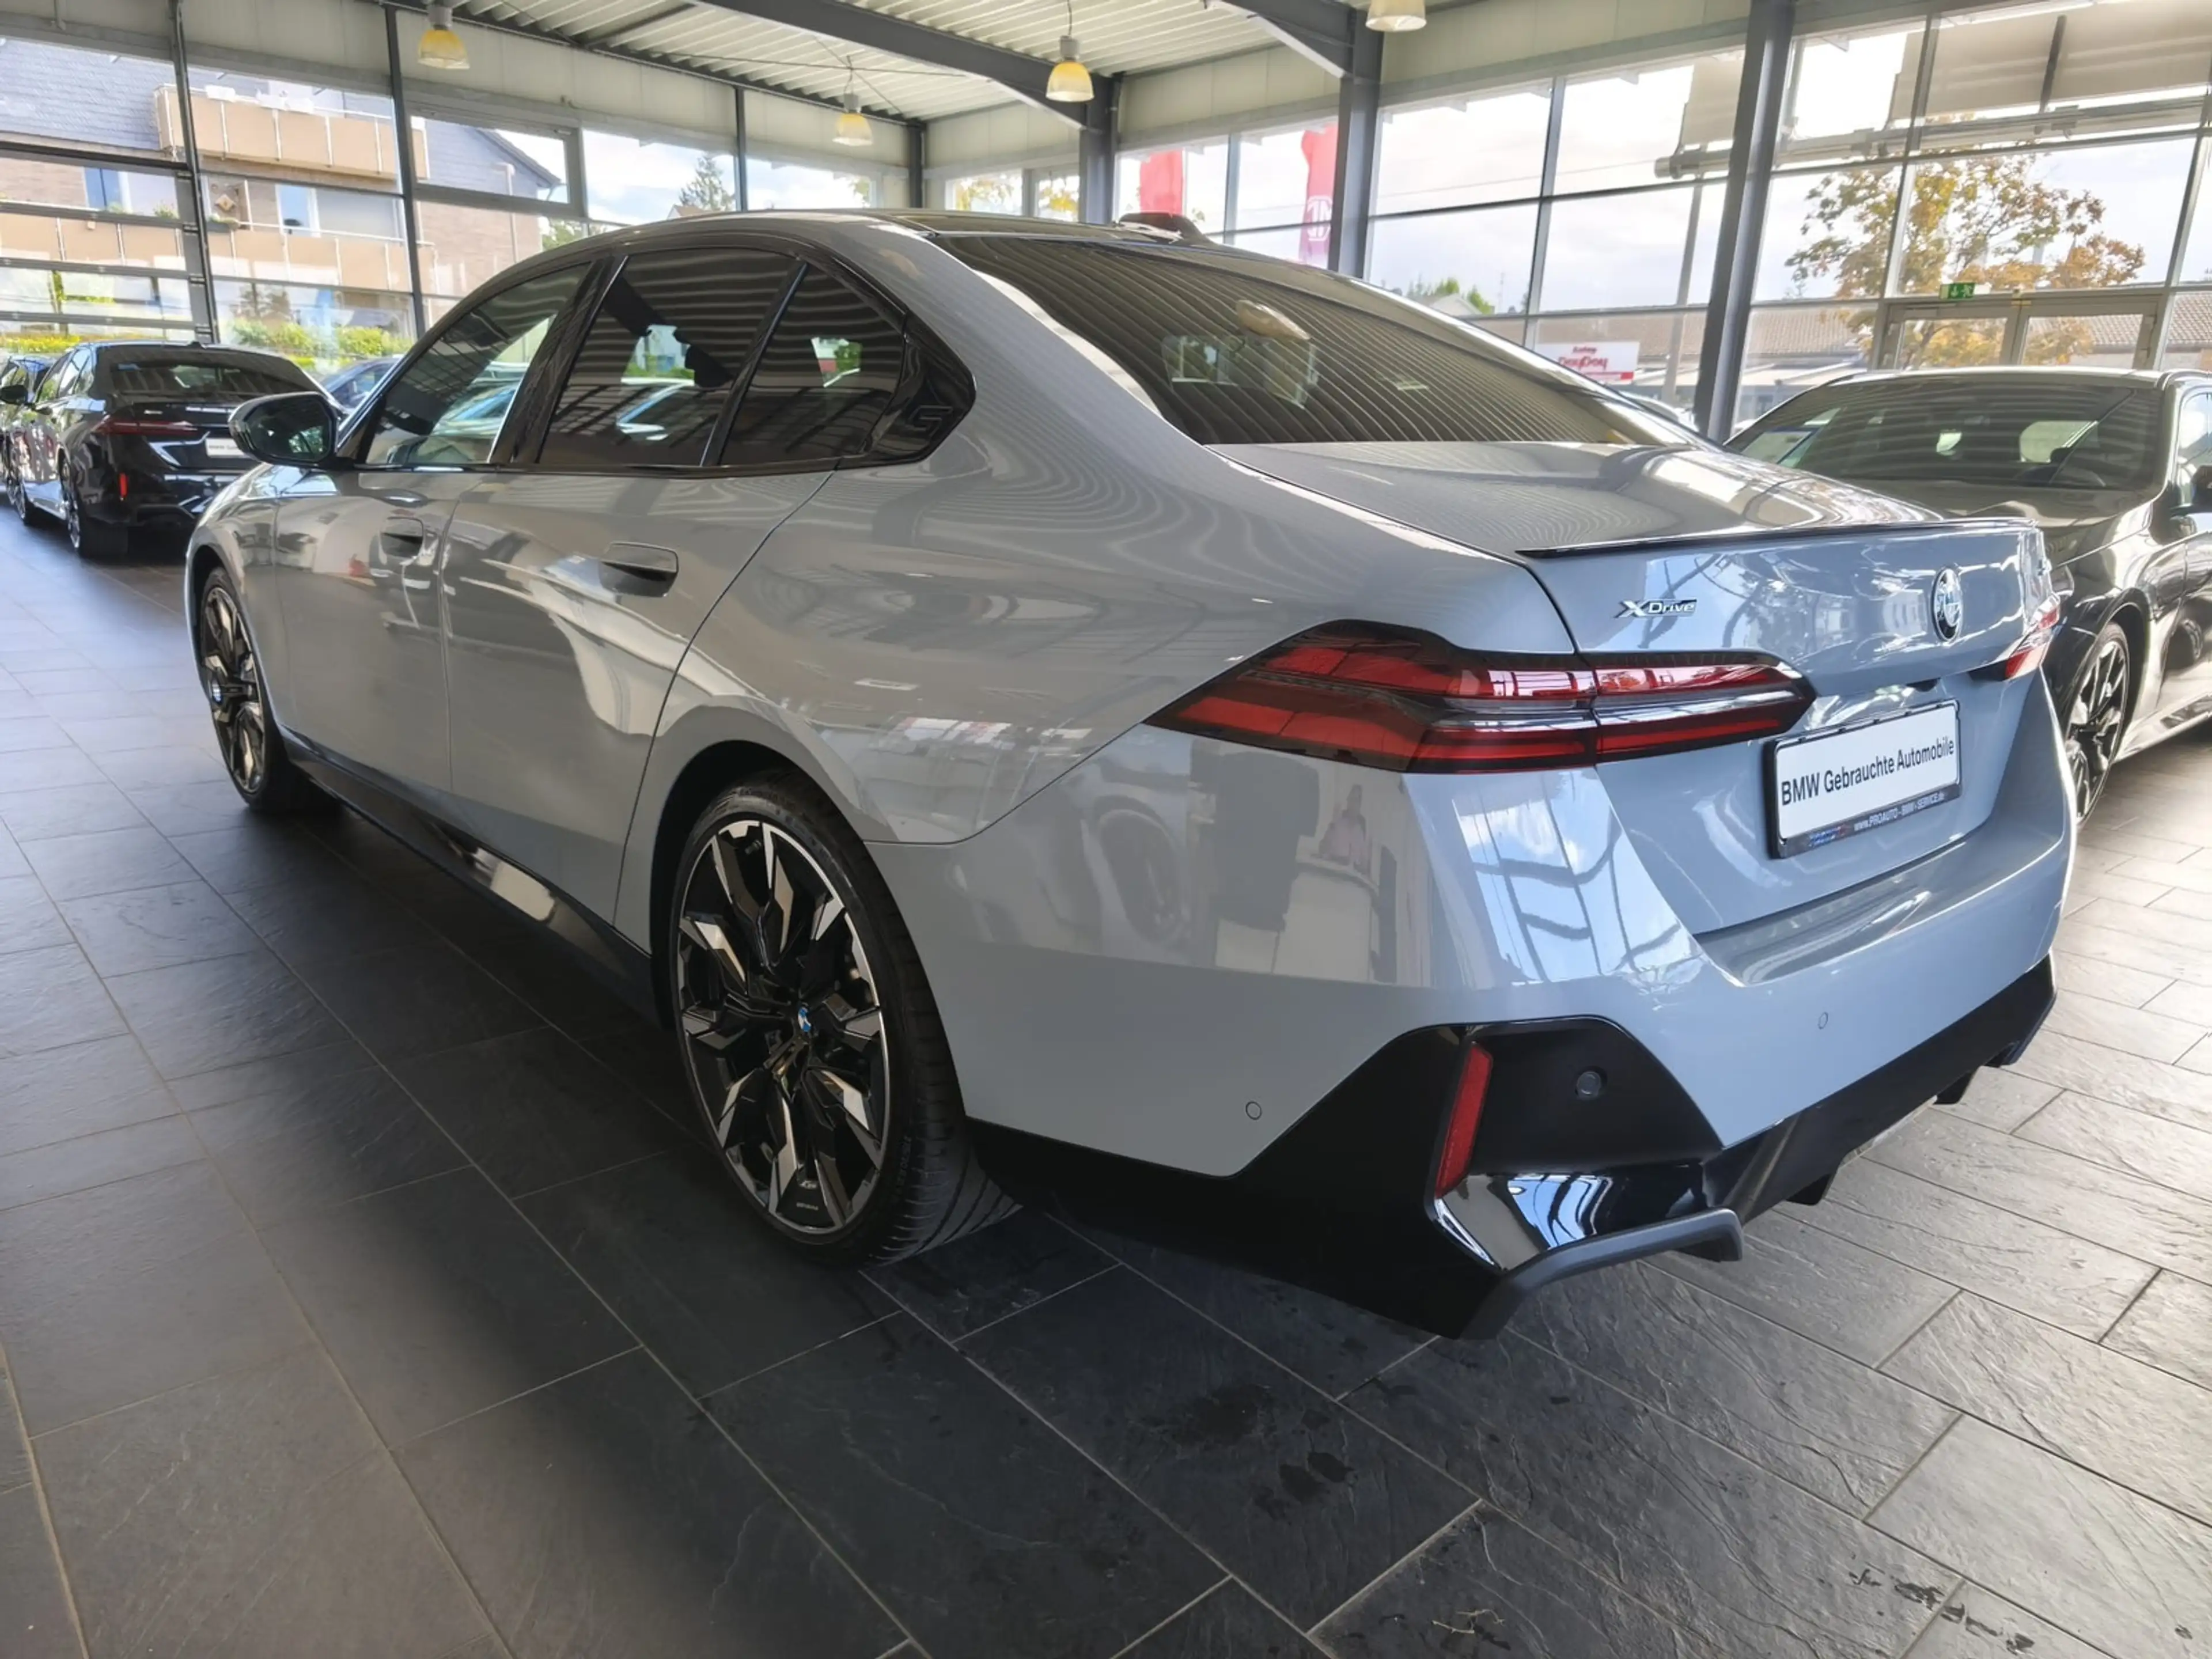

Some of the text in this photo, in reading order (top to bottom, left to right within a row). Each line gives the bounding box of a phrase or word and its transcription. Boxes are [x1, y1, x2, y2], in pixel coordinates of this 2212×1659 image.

[1781, 736, 1954, 806] BMW Gebrauchte Automobile
